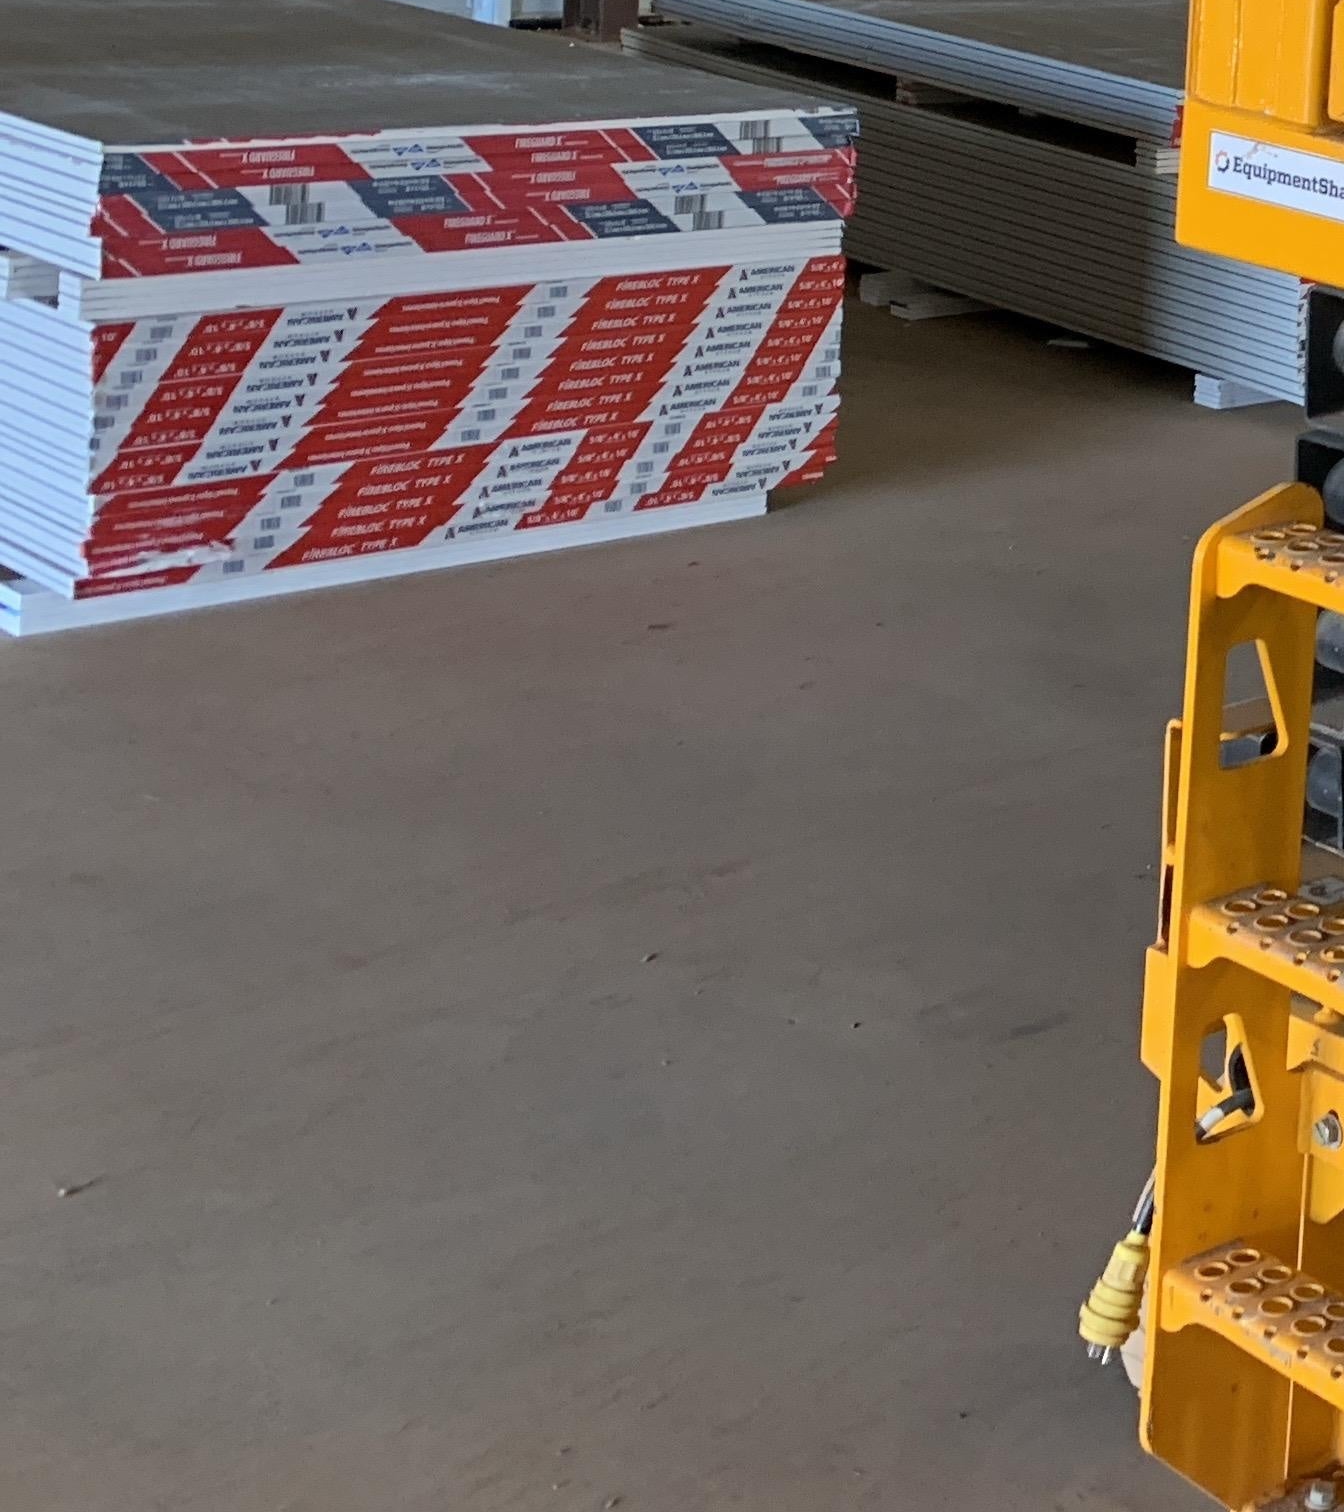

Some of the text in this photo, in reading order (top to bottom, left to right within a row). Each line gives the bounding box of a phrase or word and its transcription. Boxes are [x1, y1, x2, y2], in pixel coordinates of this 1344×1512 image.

[751, 265, 795, 276] AMERICAN
[667, 276, 690, 286] TYPE
[691, 275, 699, 284] X
[739, 283, 783, 294] AMERICAN
[656, 294, 678, 304] TYPE
[680, 294, 688, 302] X
[728, 303, 772, 313] AMERICAN
[643, 314, 666, 325] TYPE
[667, 313, 676, 322] X
[717, 322, 762, 333] AMERICAN
[632, 335, 656, 345] TYPE
[658, 333, 666, 342] X
[706, 341, 751, 352] AMERICAN
[621, 354, 644, 364] TYPE
[647, 353, 655, 361] X
[695, 360, 740, 371] AMERICAN
[609, 374, 633, 384] TYPE
[635, 372, 644, 381] X
[685, 379, 730, 390] AMERICAN
[599, 394, 622, 404] TYPE
[624, 392, 633, 401] X
[670, 398, 716, 410] AMERICAN
[584, 413, 608, 424] TYPE
[609, 412, 619, 421] X
[428, 457, 451, 468] TYPE
[454, 454, 465, 463] X
[415, 476, 440, 488] TYPE
[443, 474, 452, 483] X
[396, 497, 423, 510] TYPE
[425, 496, 433, 505] X
[389, 517, 416, 529] TYPE
[418, 516, 427, 525] X
[361, 539, 387, 552] TYPE
[390, 538, 398, 546] X
